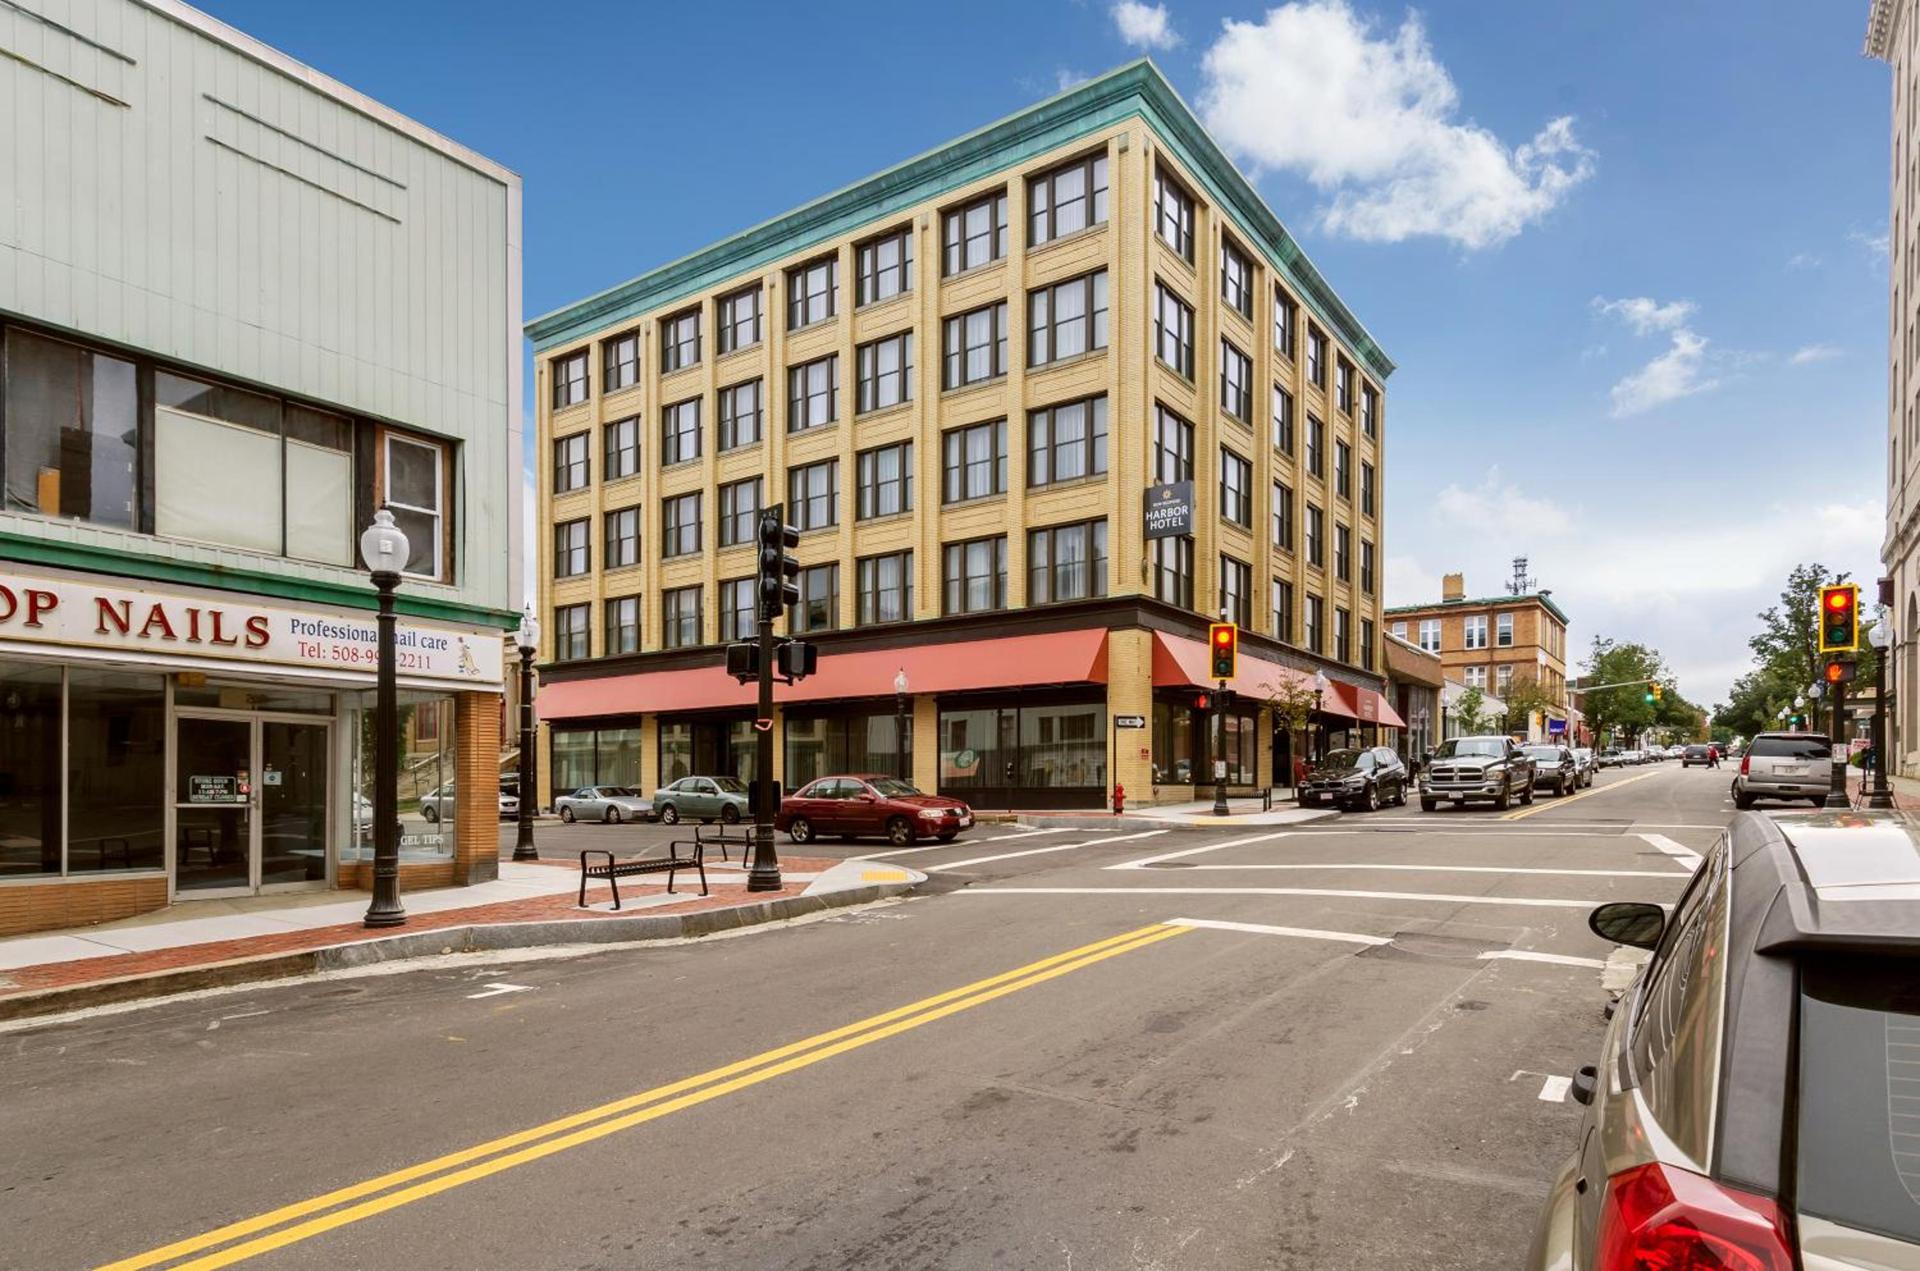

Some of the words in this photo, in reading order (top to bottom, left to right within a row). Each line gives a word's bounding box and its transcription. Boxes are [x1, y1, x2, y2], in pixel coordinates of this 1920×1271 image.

[1146, 505, 1188, 520] HARBOR
[1150, 516, 1184, 530] HOTEL
[94, 597, 271, 649] NAILS
[290, 618, 378, 643] Professiona
[420, 636, 448, 651] care
[298, 640, 326, 659] Tel:
